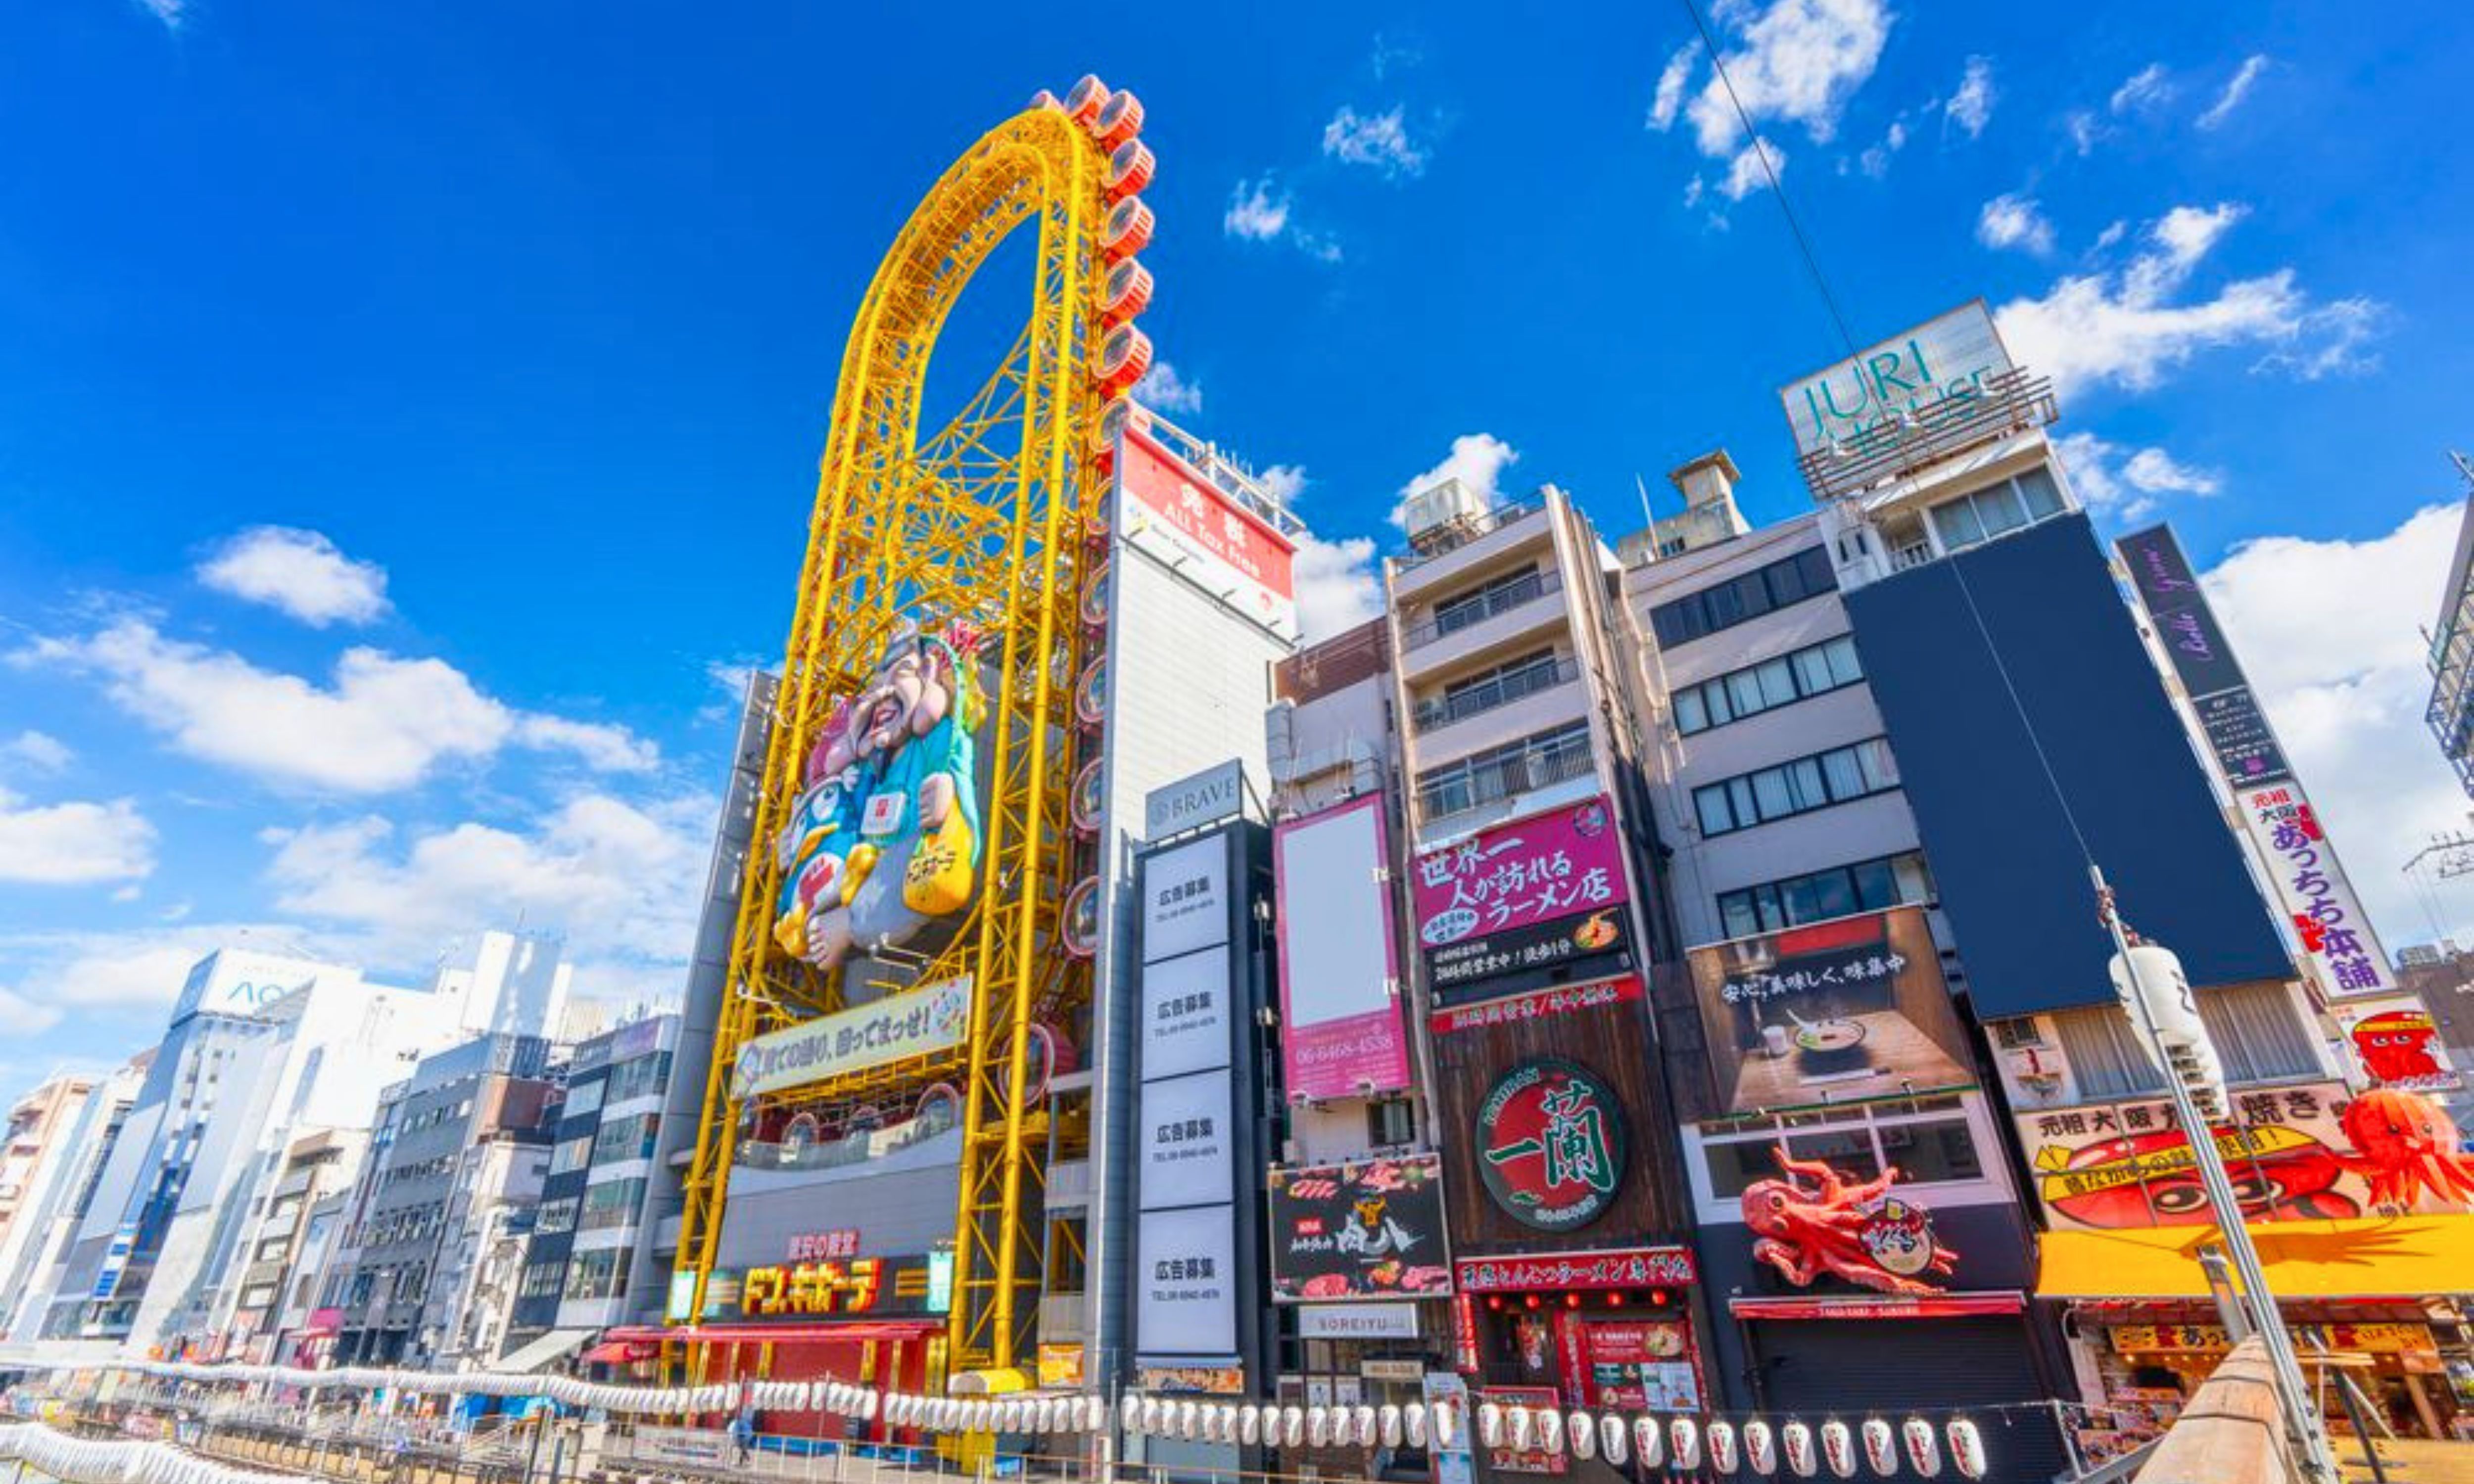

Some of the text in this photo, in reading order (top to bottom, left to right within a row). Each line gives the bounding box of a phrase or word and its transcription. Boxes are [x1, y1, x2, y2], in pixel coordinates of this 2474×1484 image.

[1804, 339, 1931, 441] JURI
[1163, 503, 1191, 532] All
[1197, 523, 1226, 553] Tax
[1229, 545, 1260, 578] Free
[1172, 777, 1236, 819] BRAVE
[1420, 837, 1524, 887] 世界一
[1449, 851, 1572, 909] 人が訪れる
[1486, 868, 1612, 928] ラーメン店
[1157, 991, 1211, 1020] 広告募集
[1156, 1117, 1213, 1144] 広告募集
[1484, 1079, 1615, 1193] 一蘭
[1155, 1257, 1216, 1281] 広告募集
